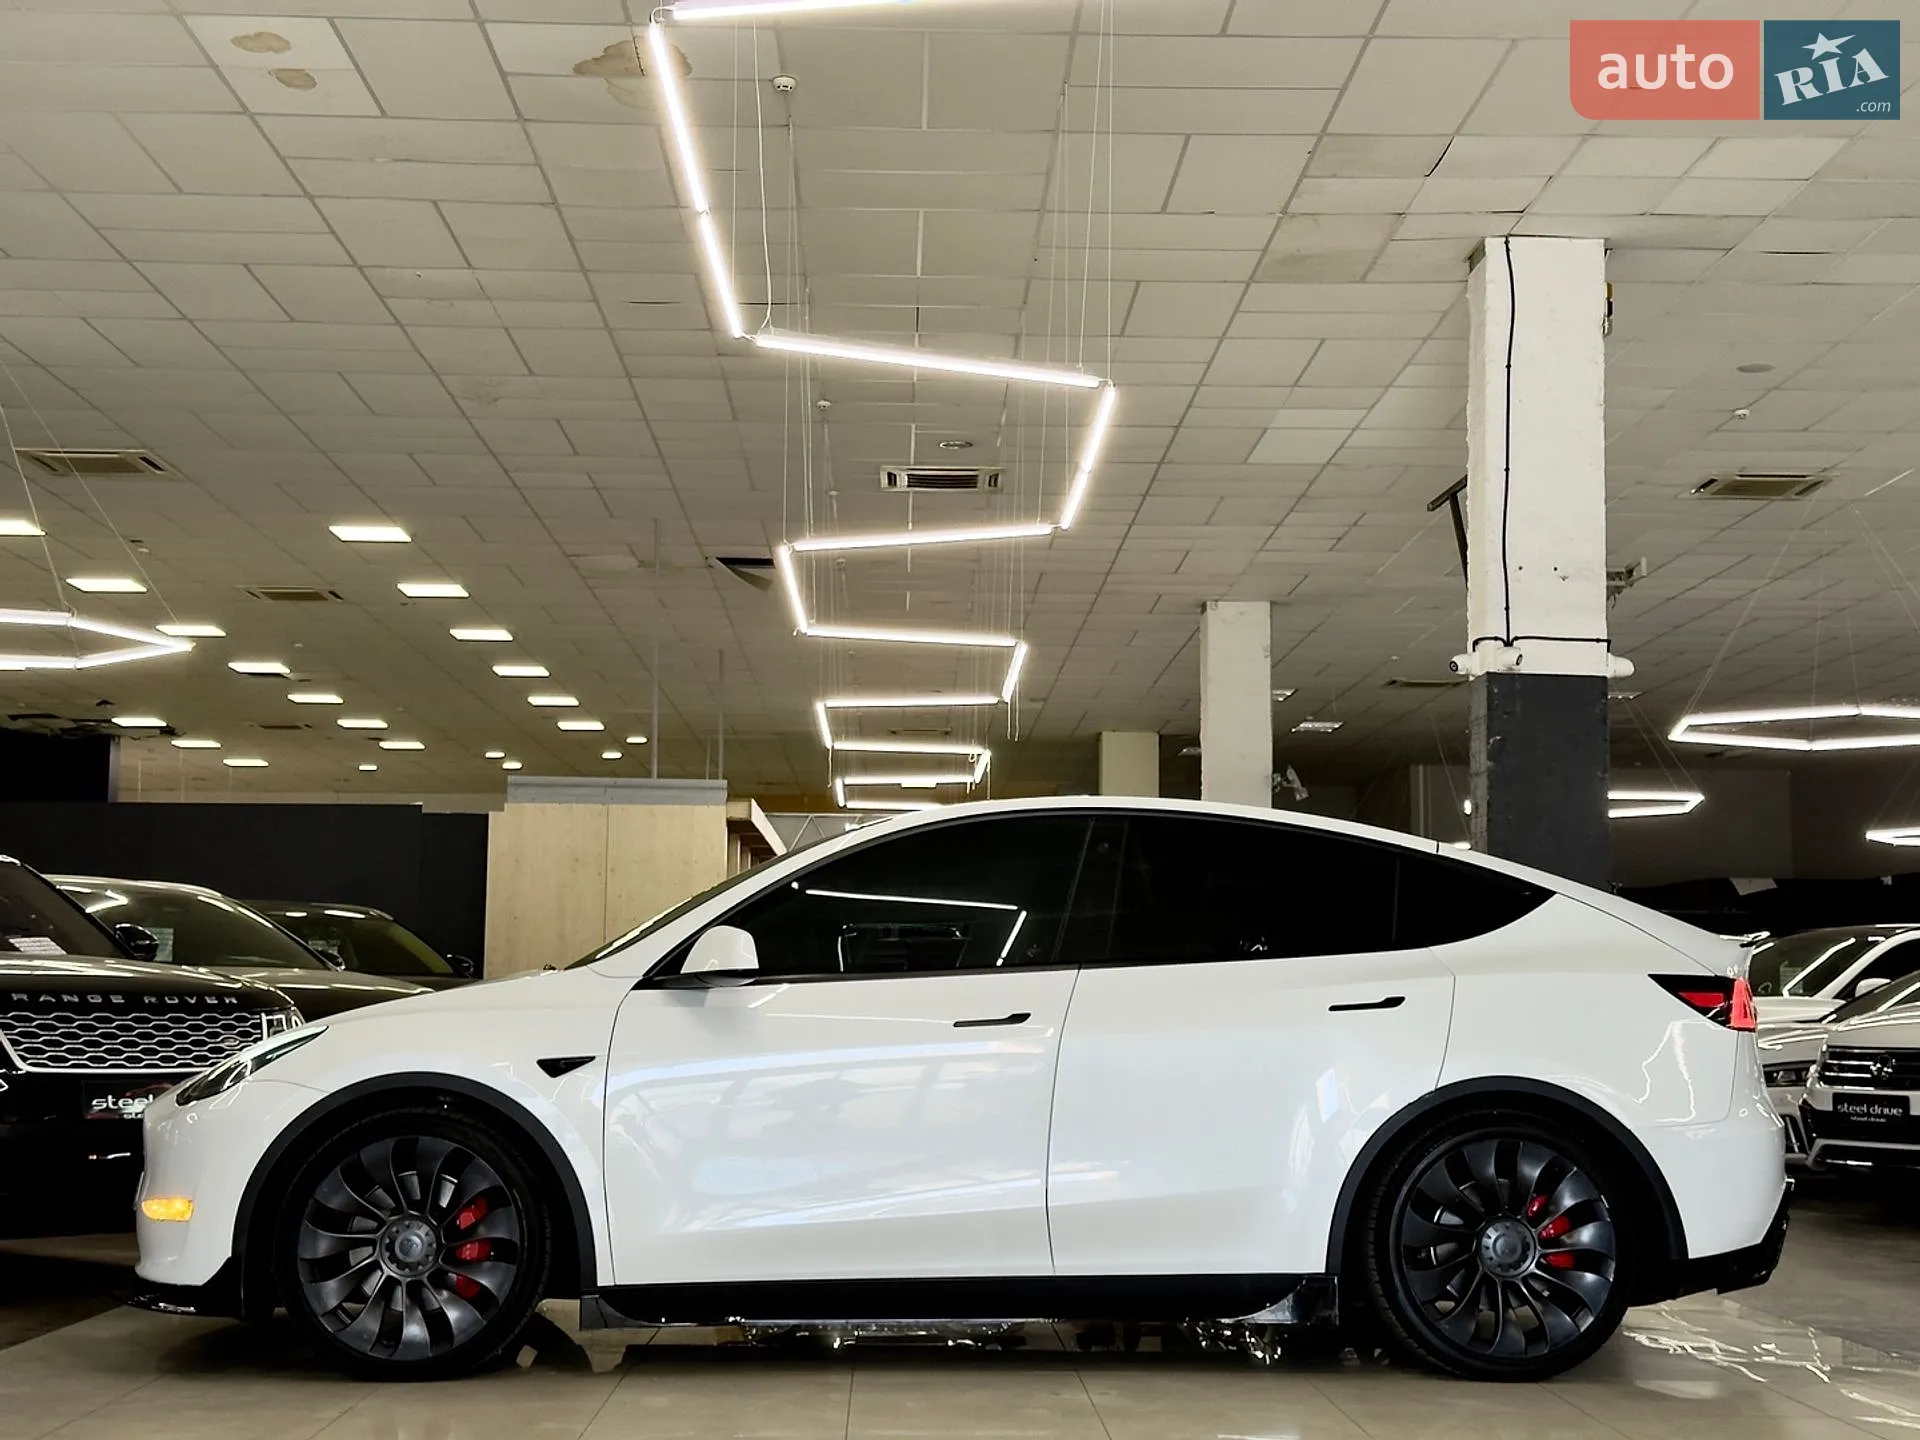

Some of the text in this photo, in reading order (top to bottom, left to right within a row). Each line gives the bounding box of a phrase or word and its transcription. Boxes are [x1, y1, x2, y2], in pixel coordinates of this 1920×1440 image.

[11, 993, 238, 1004] RANGE ROVER
[1837, 1102, 1903, 1116] steel drive
